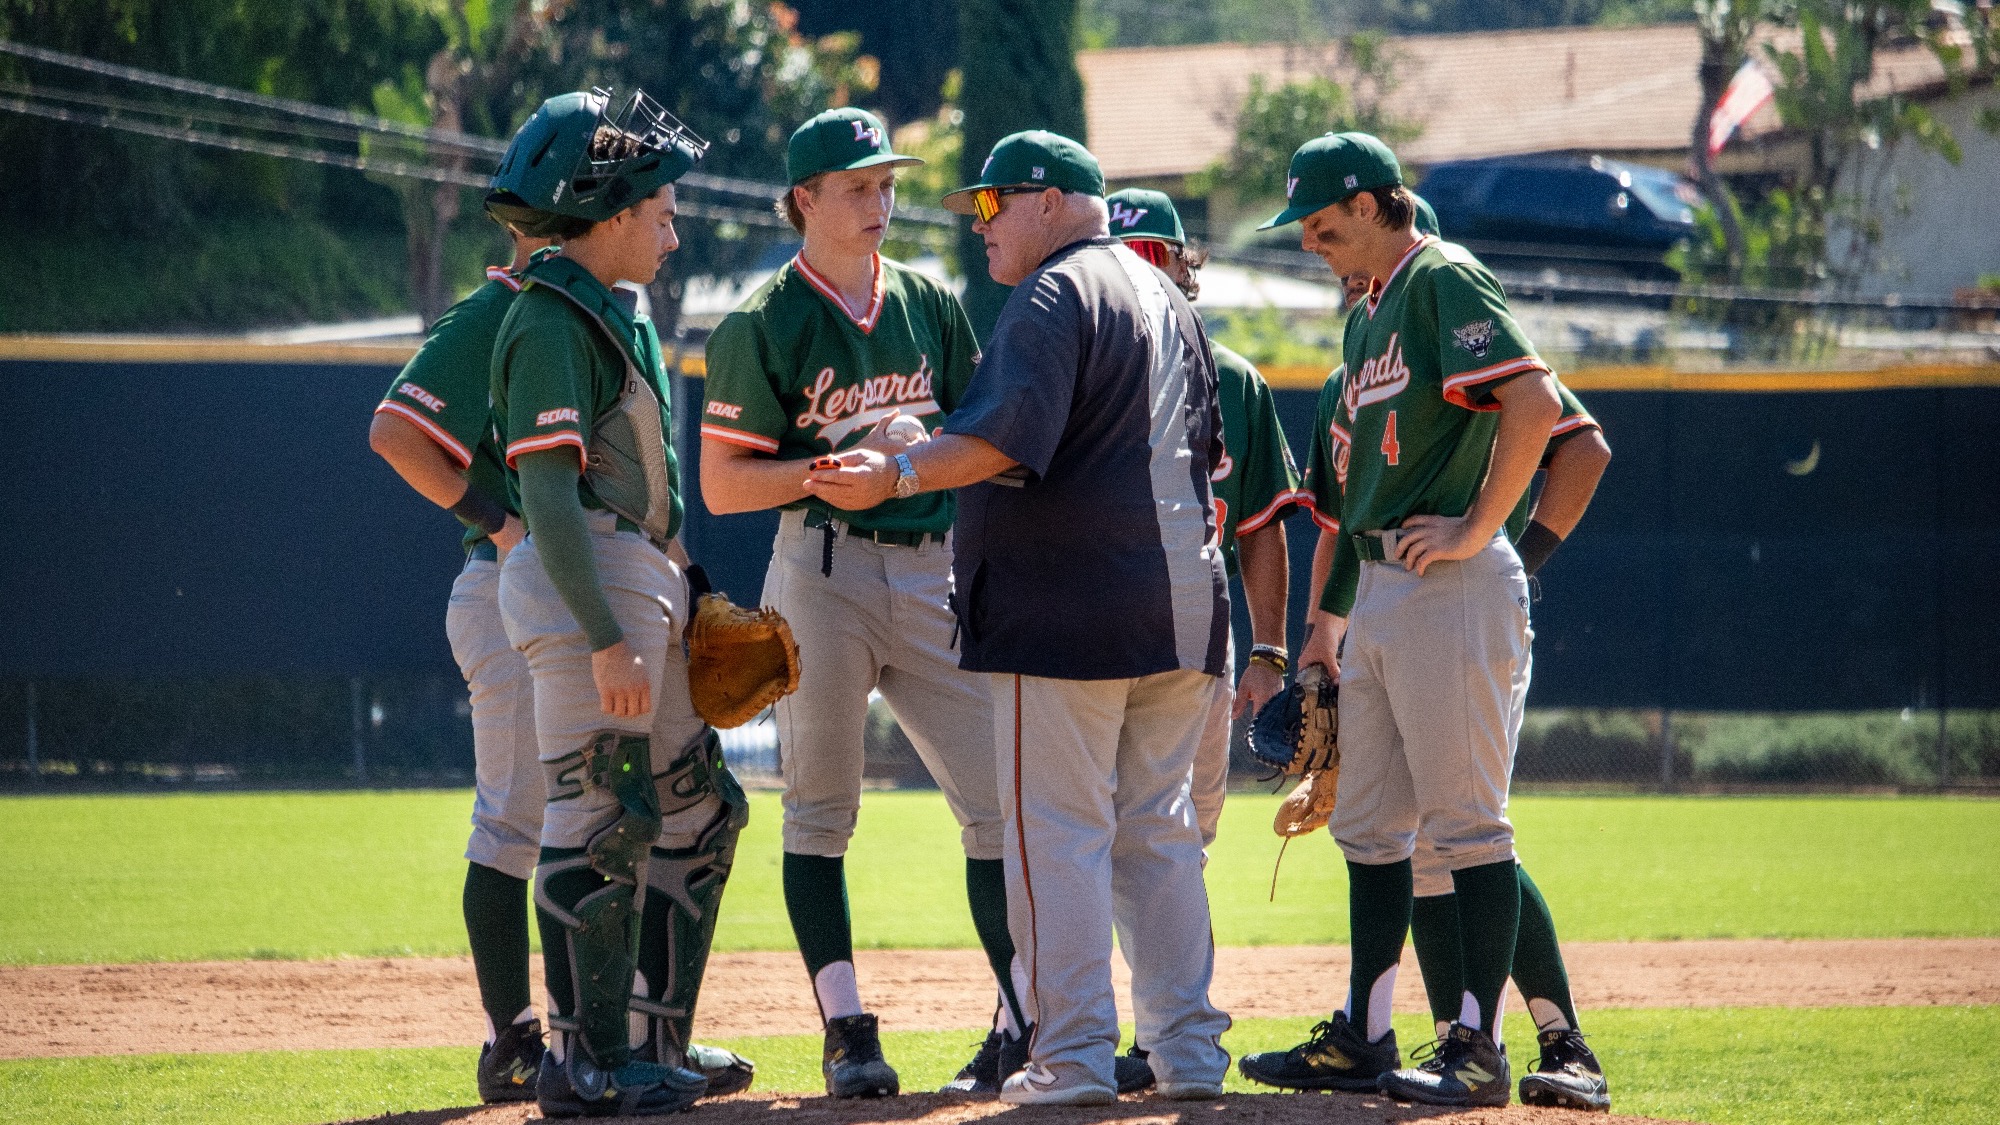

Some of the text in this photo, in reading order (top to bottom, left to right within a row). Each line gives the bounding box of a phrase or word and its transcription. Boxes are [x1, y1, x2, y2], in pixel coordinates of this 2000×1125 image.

[851, 120, 882, 148] LV
[1286, 176, 1300, 199] V
[1110, 202, 1149, 228] LV
[398, 382, 447, 413] SCIAC
[706, 400, 744, 420] SCIAC
[535, 407, 579, 427] SCIAC
[1380, 410, 1401, 466] 4
